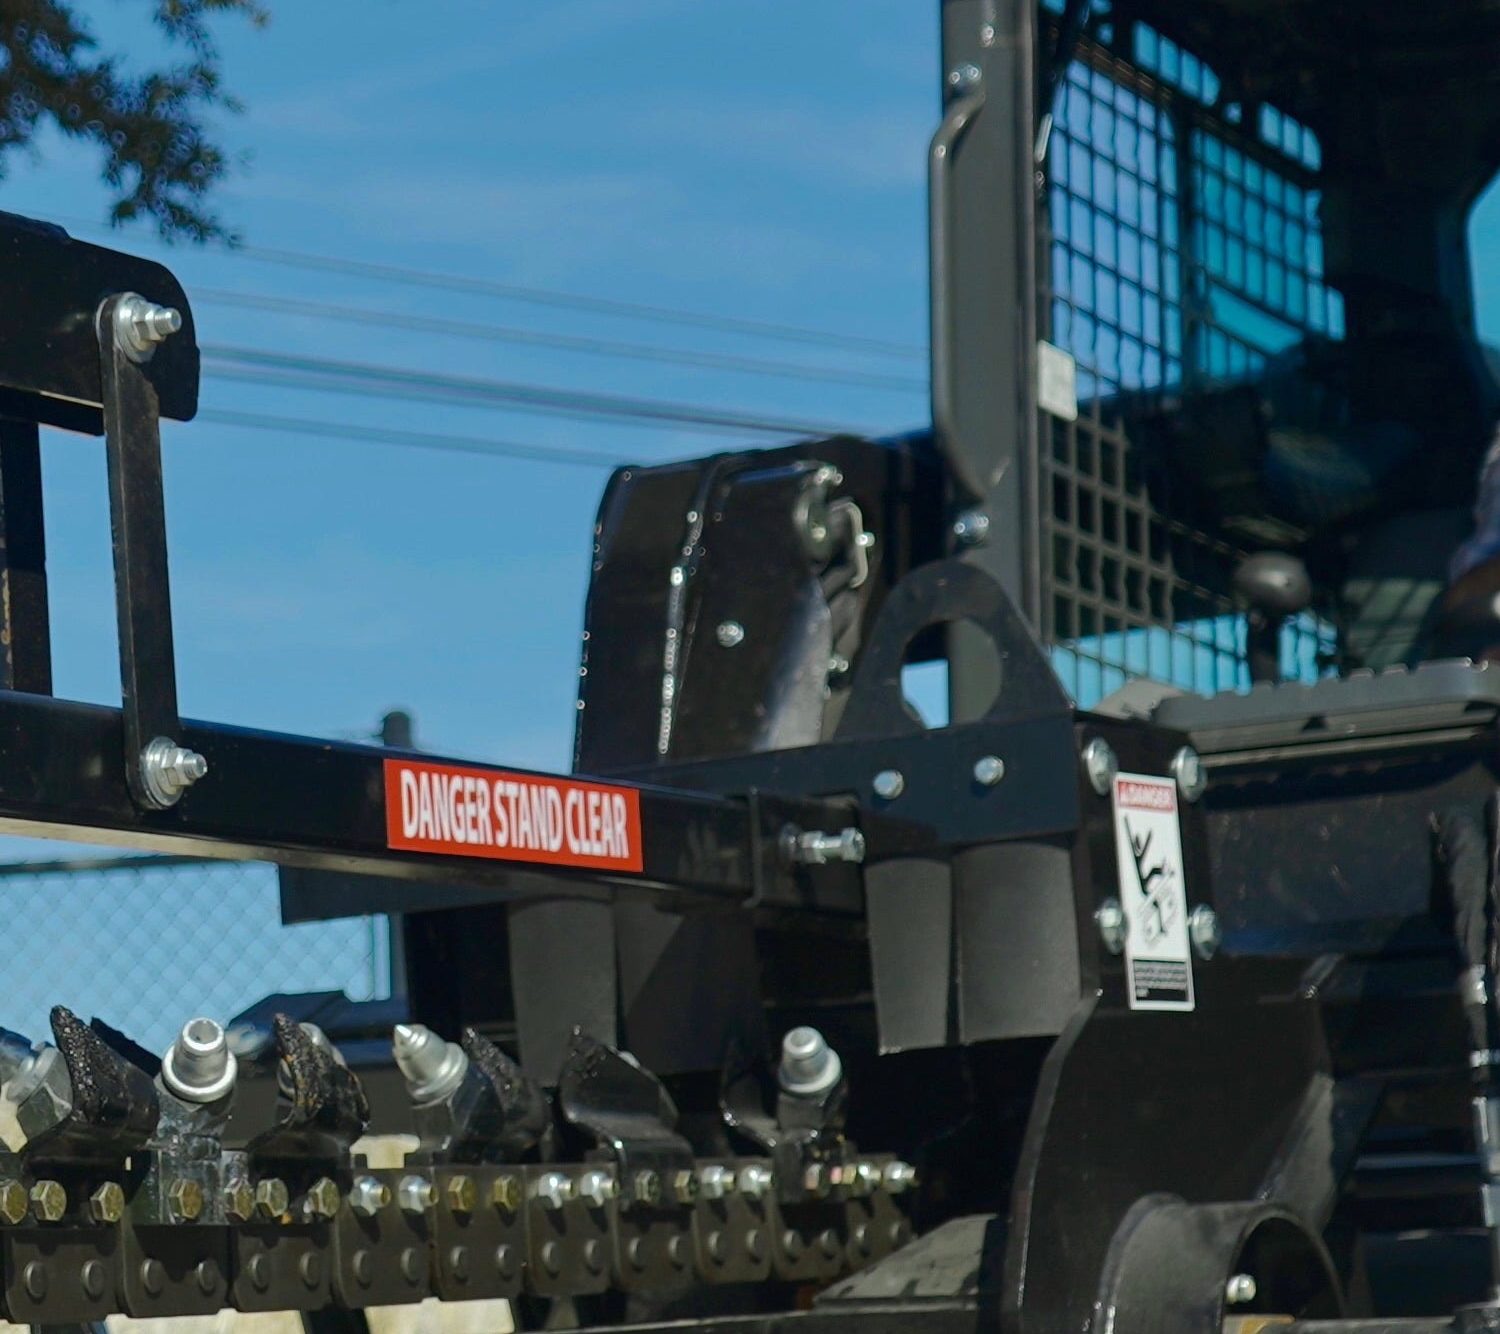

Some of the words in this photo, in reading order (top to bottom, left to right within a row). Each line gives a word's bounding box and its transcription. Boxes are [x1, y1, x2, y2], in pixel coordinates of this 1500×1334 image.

[400, 768, 493, 846] DANGER
[493, 779, 564, 853] STAND
[564, 788, 630, 859] CLEAR
